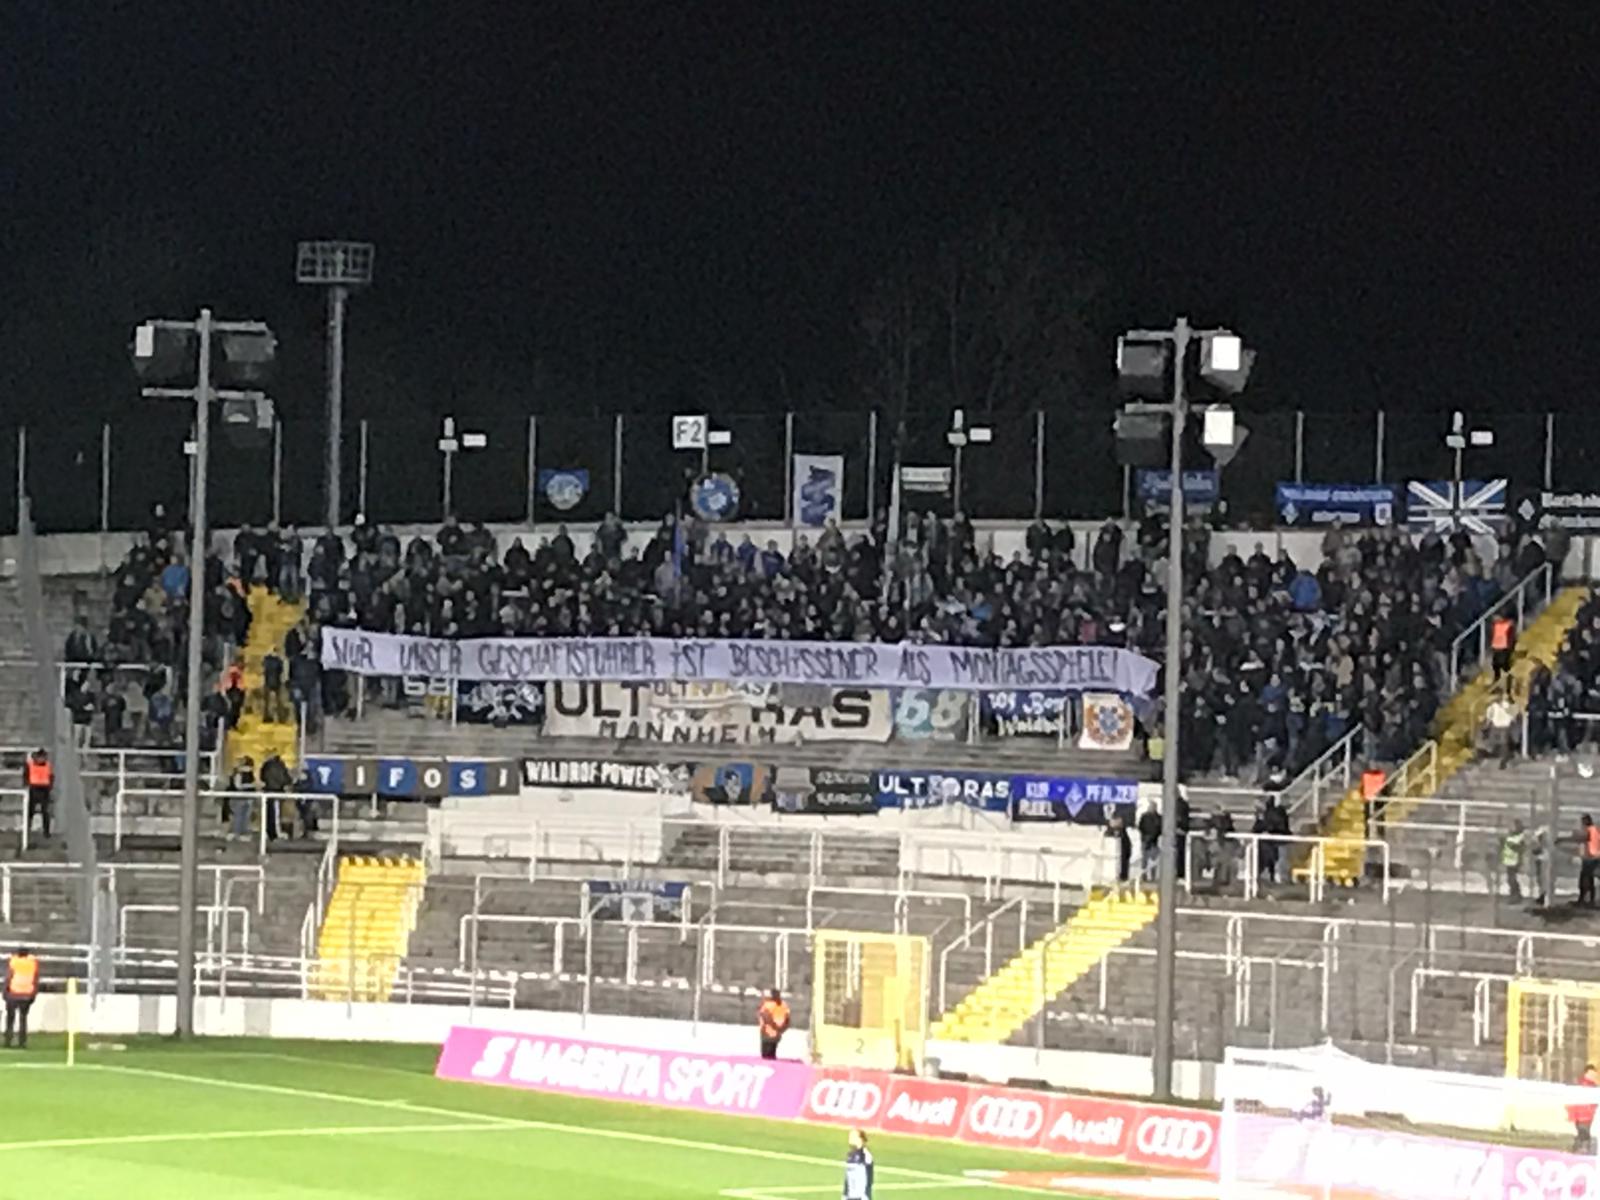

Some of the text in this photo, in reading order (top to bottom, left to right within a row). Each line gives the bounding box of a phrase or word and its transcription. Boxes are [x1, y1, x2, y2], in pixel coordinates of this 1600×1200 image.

[676, 420, 701, 442] F2
[332, 636, 375, 669] NUR
[898, 648, 931, 685] ALS
[599, 719, 776, 744] MANNHEIM
[509, 1039, 661, 1098] MAGENTA
[664, 1057, 776, 1110] SPORT
[888, 1092, 958, 1126] Audi
[1050, 1111, 1123, 1146] Audi
